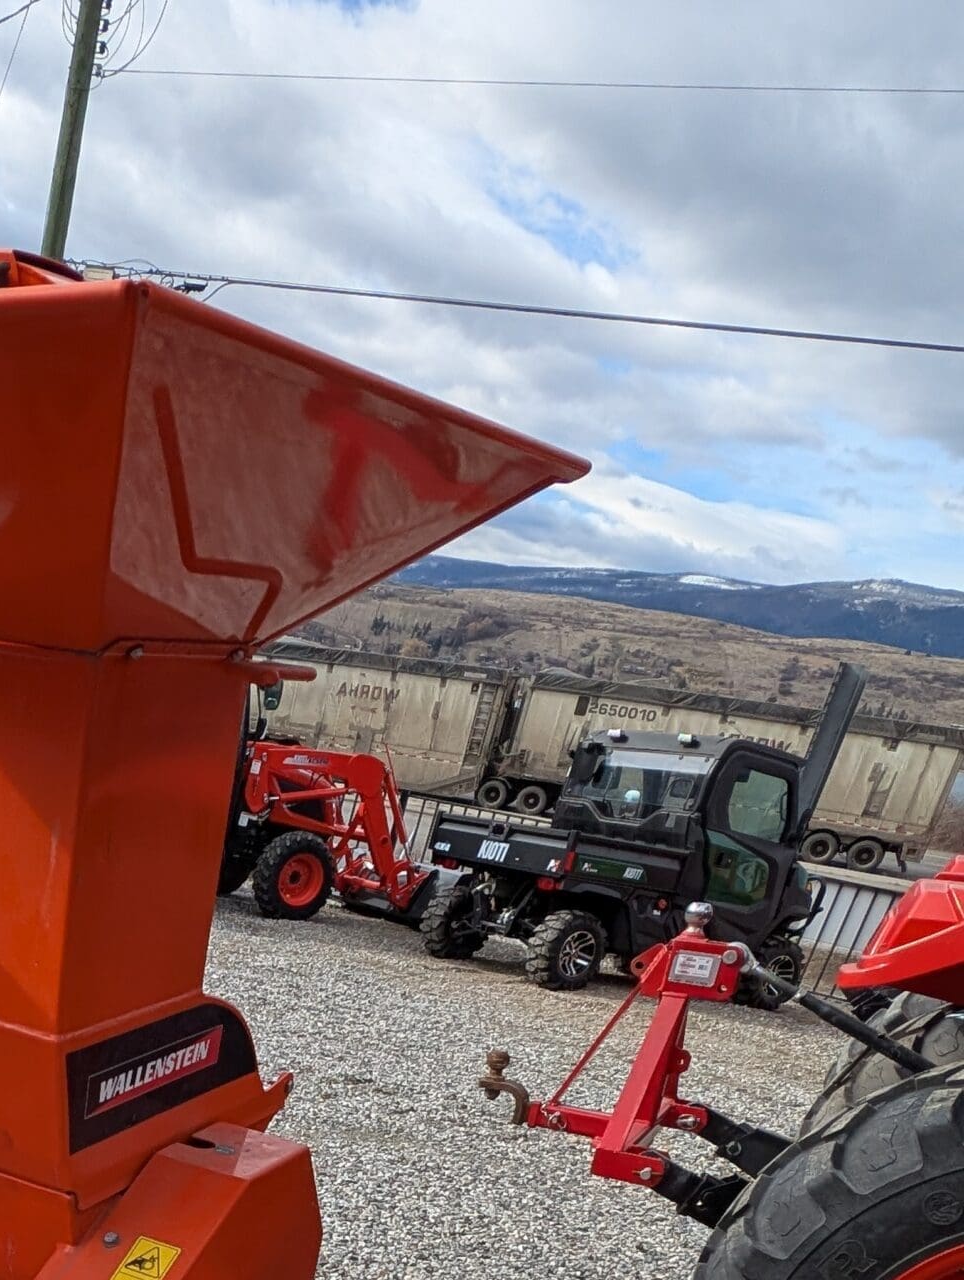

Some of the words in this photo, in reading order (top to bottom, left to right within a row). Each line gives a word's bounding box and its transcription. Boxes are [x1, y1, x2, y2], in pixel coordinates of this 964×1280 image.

[588, 702, 657, 722] 2650010
[477, 840, 510, 862] KIOTI
[98, 1039, 211, 1103] WALLENSTEIN
